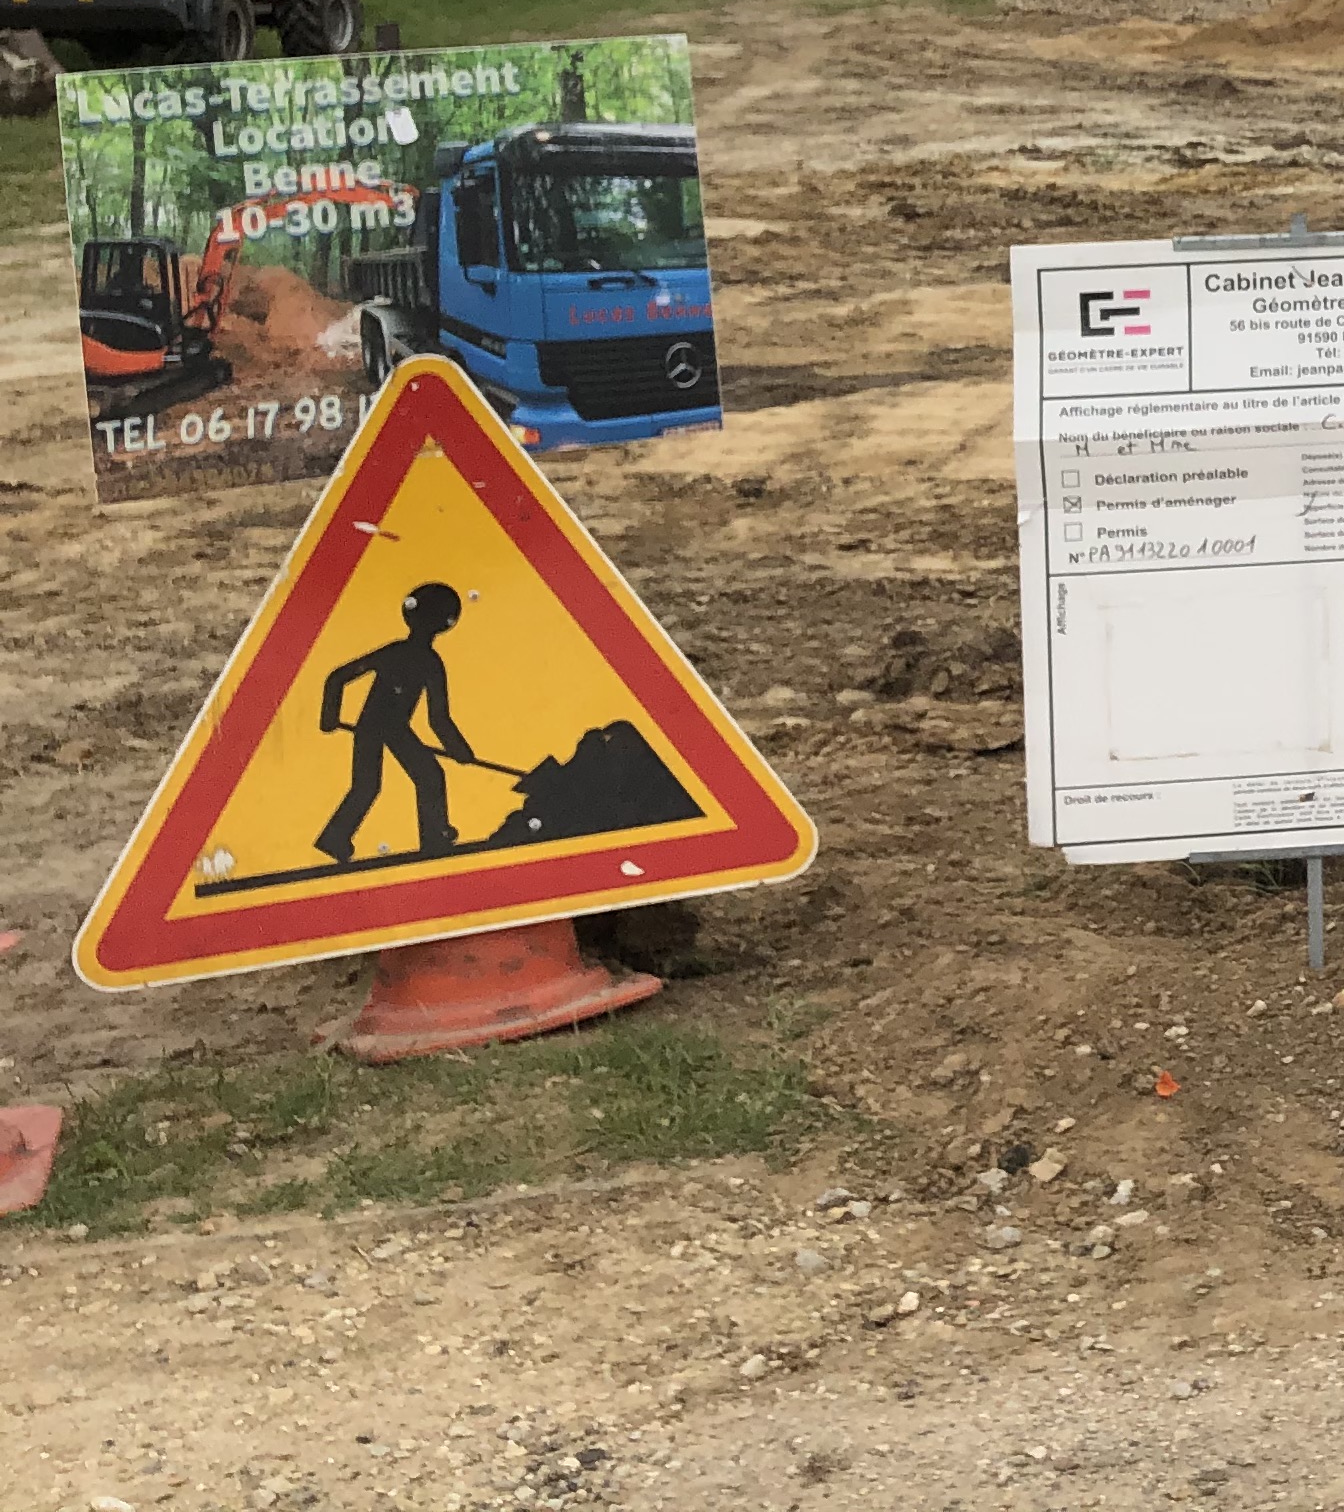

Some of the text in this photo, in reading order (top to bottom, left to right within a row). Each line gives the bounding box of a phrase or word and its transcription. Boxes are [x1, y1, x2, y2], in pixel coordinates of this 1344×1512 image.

[76, 62, 521, 123] Lucas-Terrassement
[243, 159, 382, 196] Benne
[216, 184, 416, 243] 10-30 m3
[1204, 271, 1296, 293] Cabinet
[1250, 319, 1271, 331] bis
[1275, 317, 1311, 330] route
[1315, 316, 1331, 328] de
[1298, 331, 1338, 344] 91590
[1250, 365, 1293, 378] Email:
[1059, 405, 1123, 419] Affichage
[1127, 401, 1219, 417] réglementaire
[1222, 399, 1239, 410] au
[1243, 397, 1269, 409] titre
[1272, 396, 1288, 408] de
[1292, 394, 1341, 407] l'article
[95, 413, 166, 453] TEL
[180, 406, 231, 445] 06
[247, 401, 280, 440] 17
[294, 394, 343, 433] 98
[1059, 432, 1090, 444] Nom
[1092, 431, 1108, 442] du
[1191, 426, 1207, 437] ou
[1211, 424, 1251, 436] raison
[1254, 422, 1300, 434] sociale
[1094, 467, 1249, 487] Déclaration préalable
[1096, 494, 1237, 512] Permis d'aménager
[1097, 525, 1148, 539] Permis
[1056, 582, 1068, 636] Affichage
